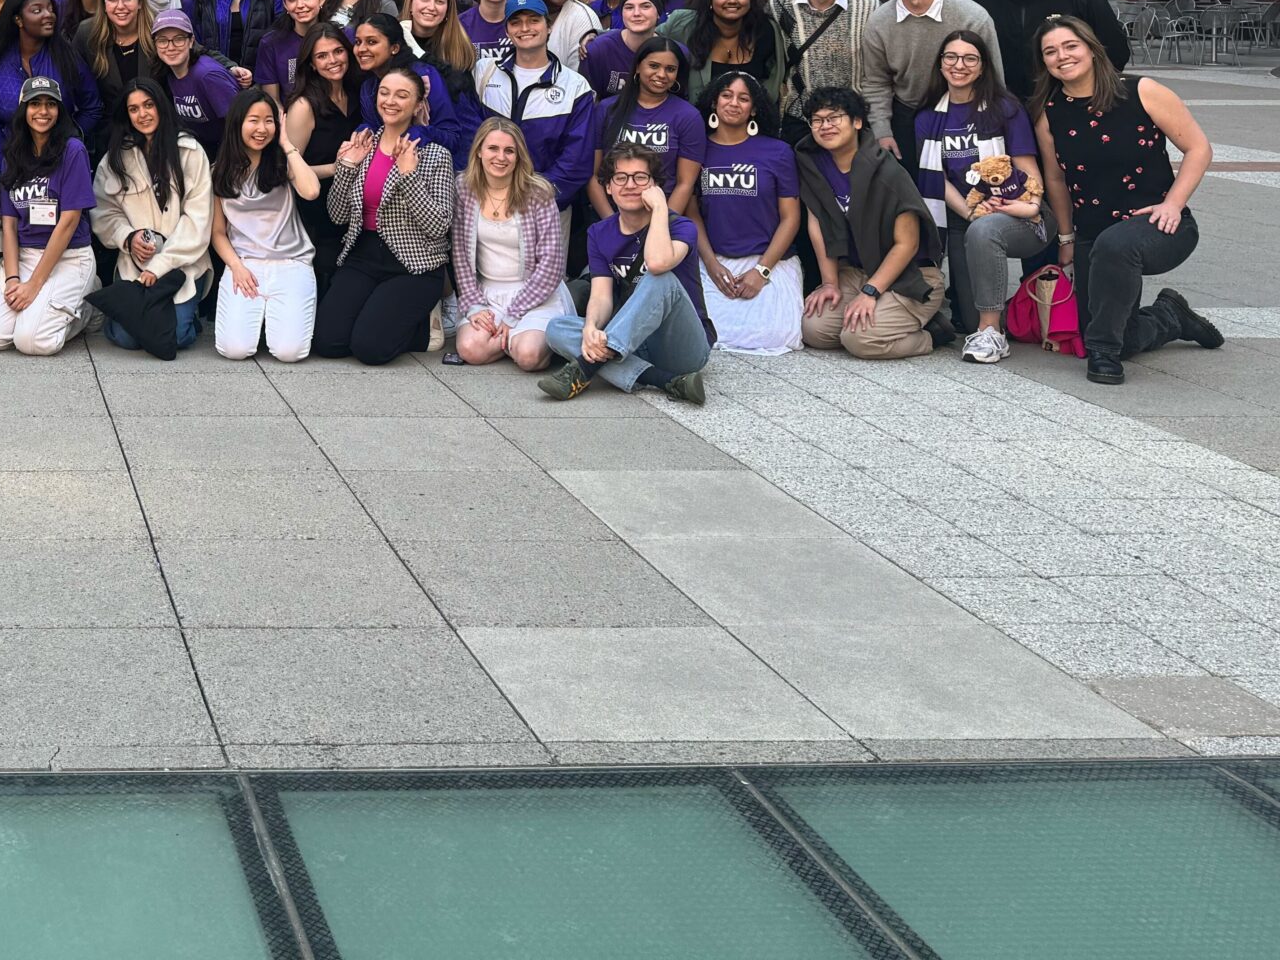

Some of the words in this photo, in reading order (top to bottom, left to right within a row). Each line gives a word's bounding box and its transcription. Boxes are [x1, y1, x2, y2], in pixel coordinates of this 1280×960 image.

[176, 103, 202, 118] NYU
[624, 130, 666, 145] NYU
[708, 174, 754, 188] NYU
